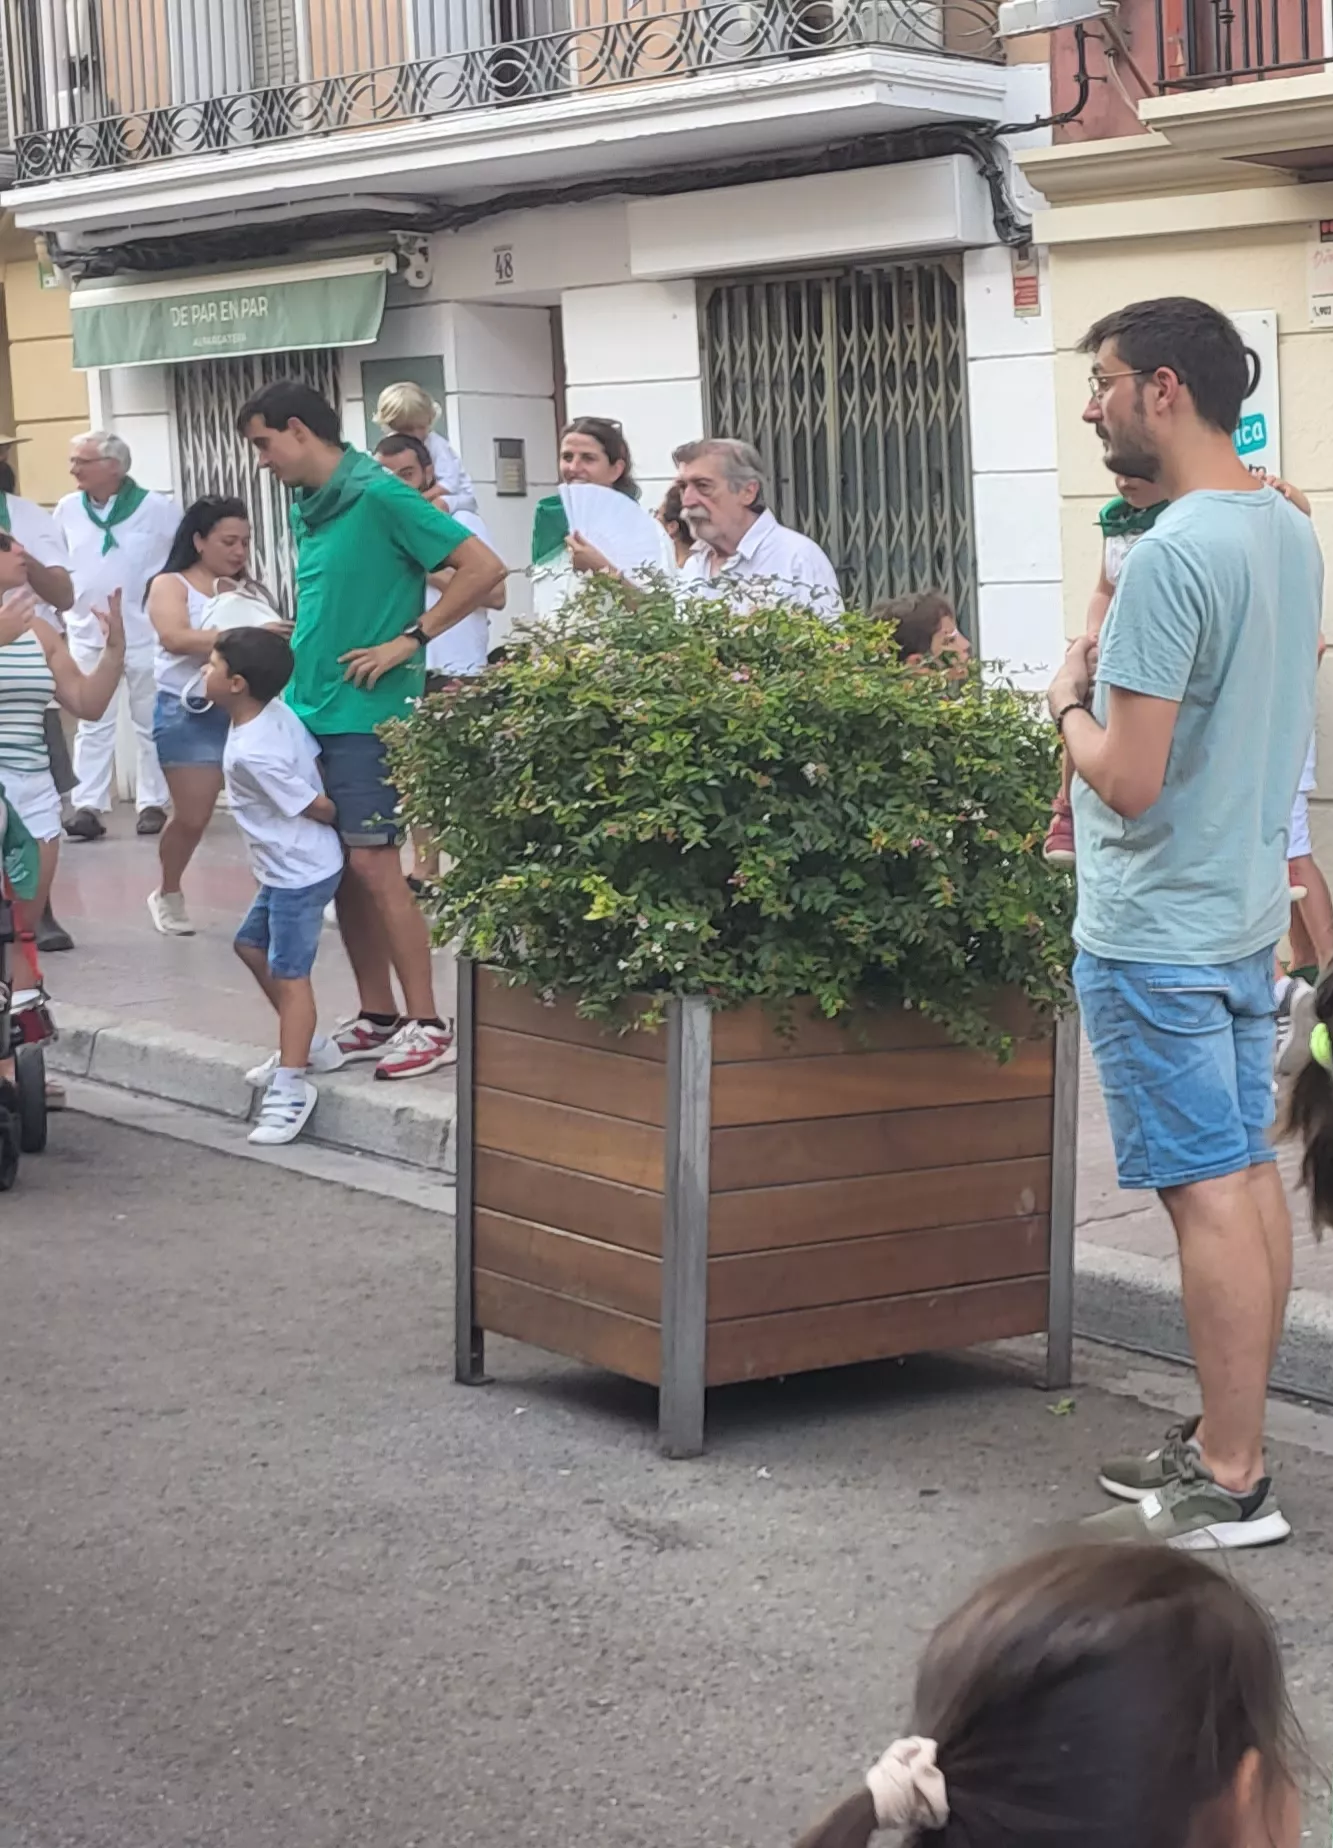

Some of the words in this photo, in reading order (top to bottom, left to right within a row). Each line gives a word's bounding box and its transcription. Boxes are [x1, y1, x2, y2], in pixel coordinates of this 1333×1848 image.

[495, 252, 513, 279] 48
[170, 306, 188, 327] DE
[191, 302, 217, 324] PAR
[220, 301, 238, 321] EN
[241, 296, 268, 318] PAR
